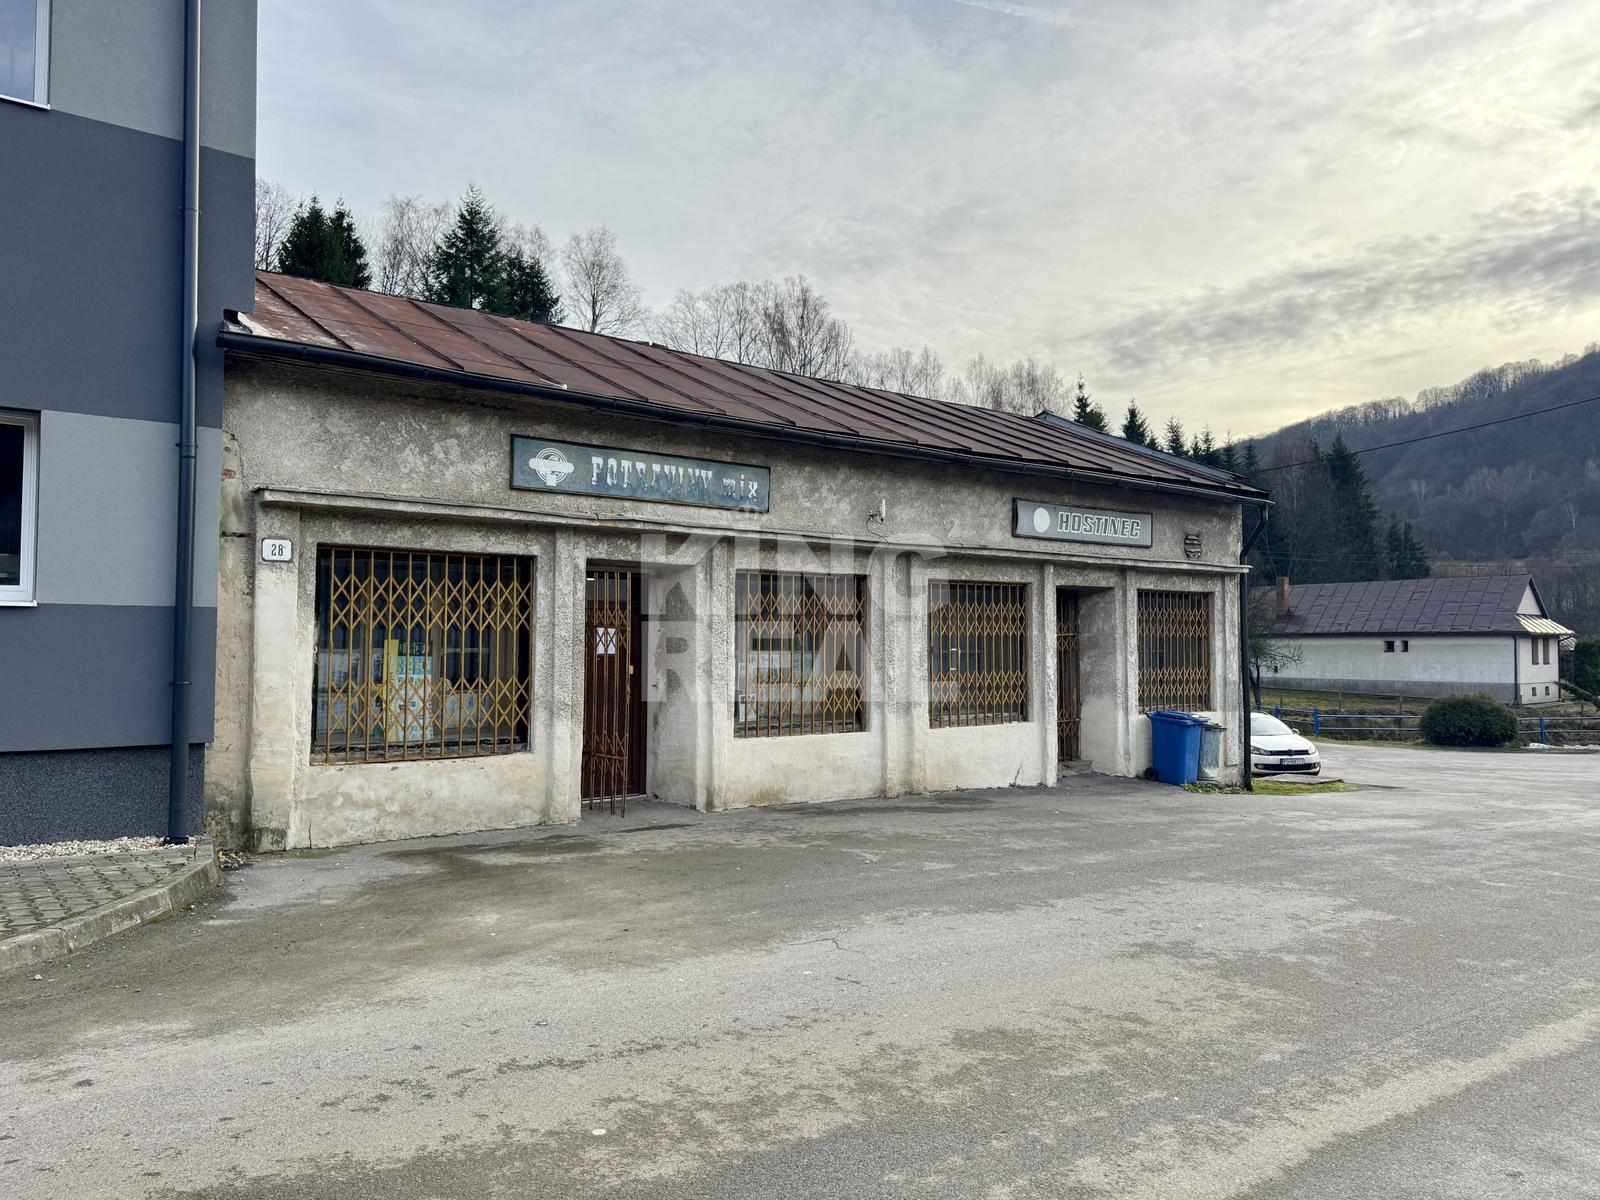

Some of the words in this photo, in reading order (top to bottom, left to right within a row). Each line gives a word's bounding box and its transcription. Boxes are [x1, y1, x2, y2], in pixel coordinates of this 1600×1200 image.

[723, 474, 758, 501] mix
[1058, 512, 1141, 539] HOSTINEC
[271, 543, 284, 556] 28
